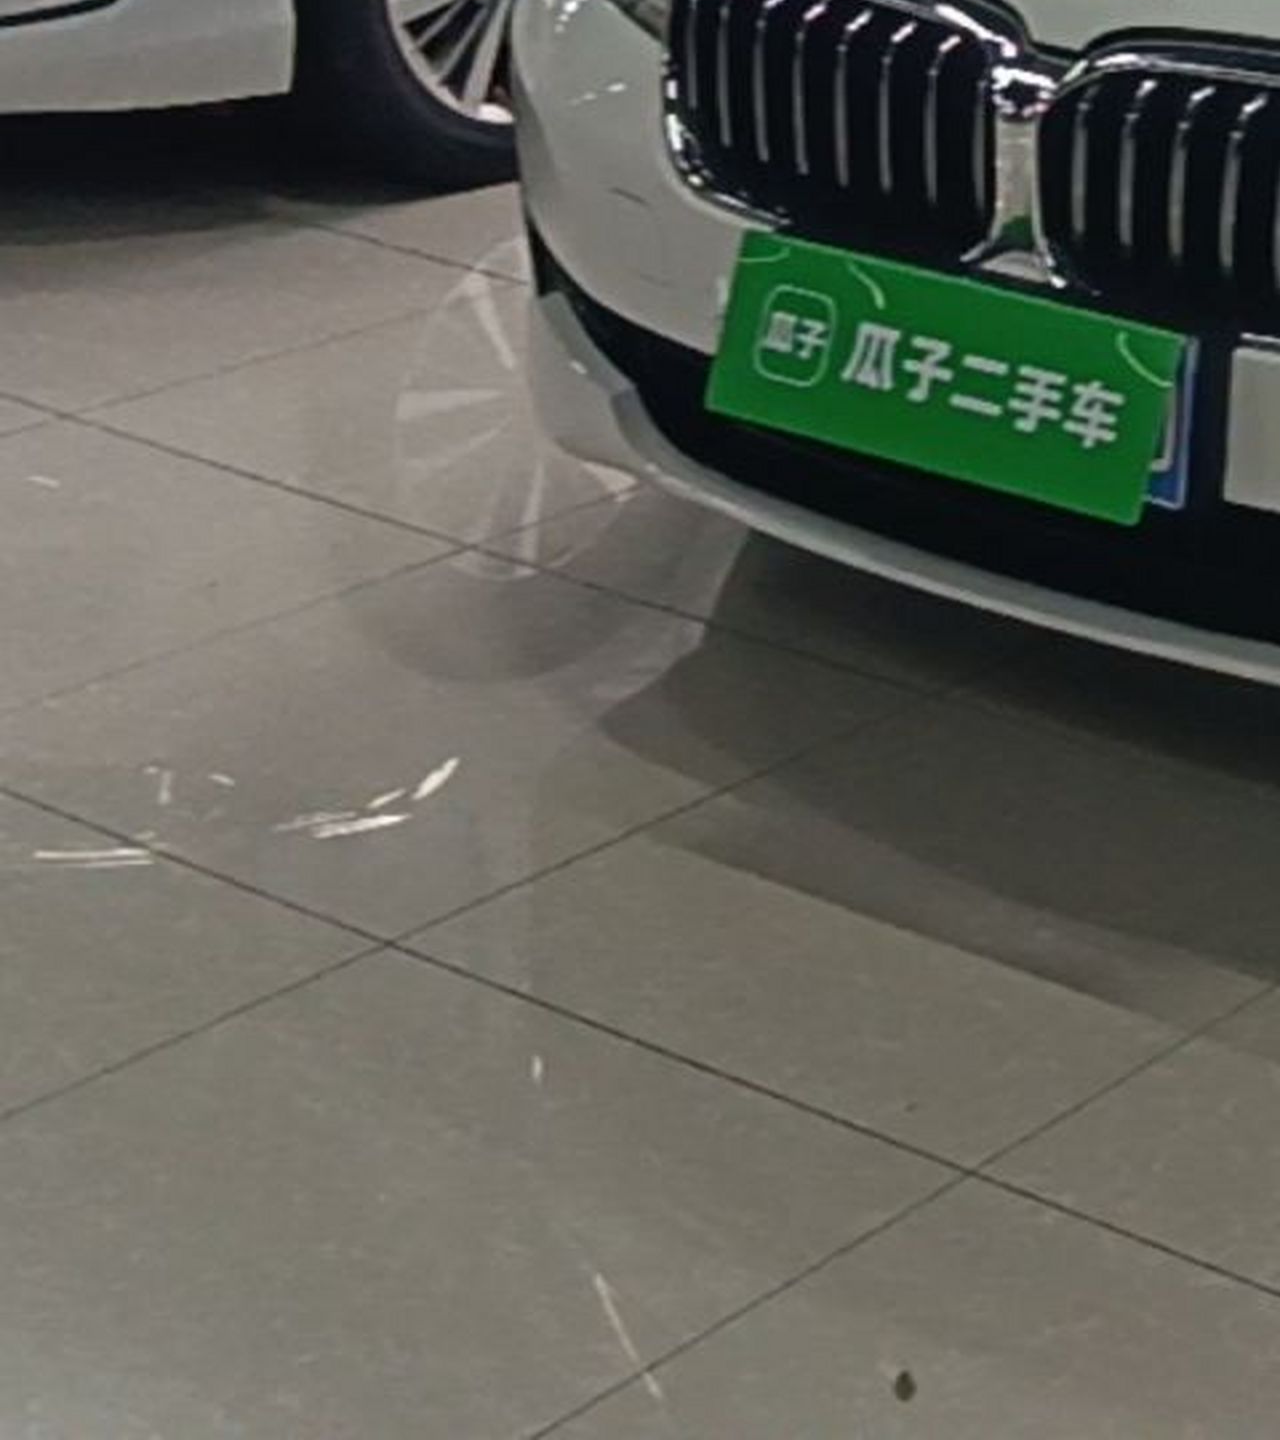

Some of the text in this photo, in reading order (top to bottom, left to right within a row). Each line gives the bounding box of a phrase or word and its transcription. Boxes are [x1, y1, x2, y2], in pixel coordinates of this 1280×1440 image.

[842, 322, 1125, 448] 瓜子二手车
